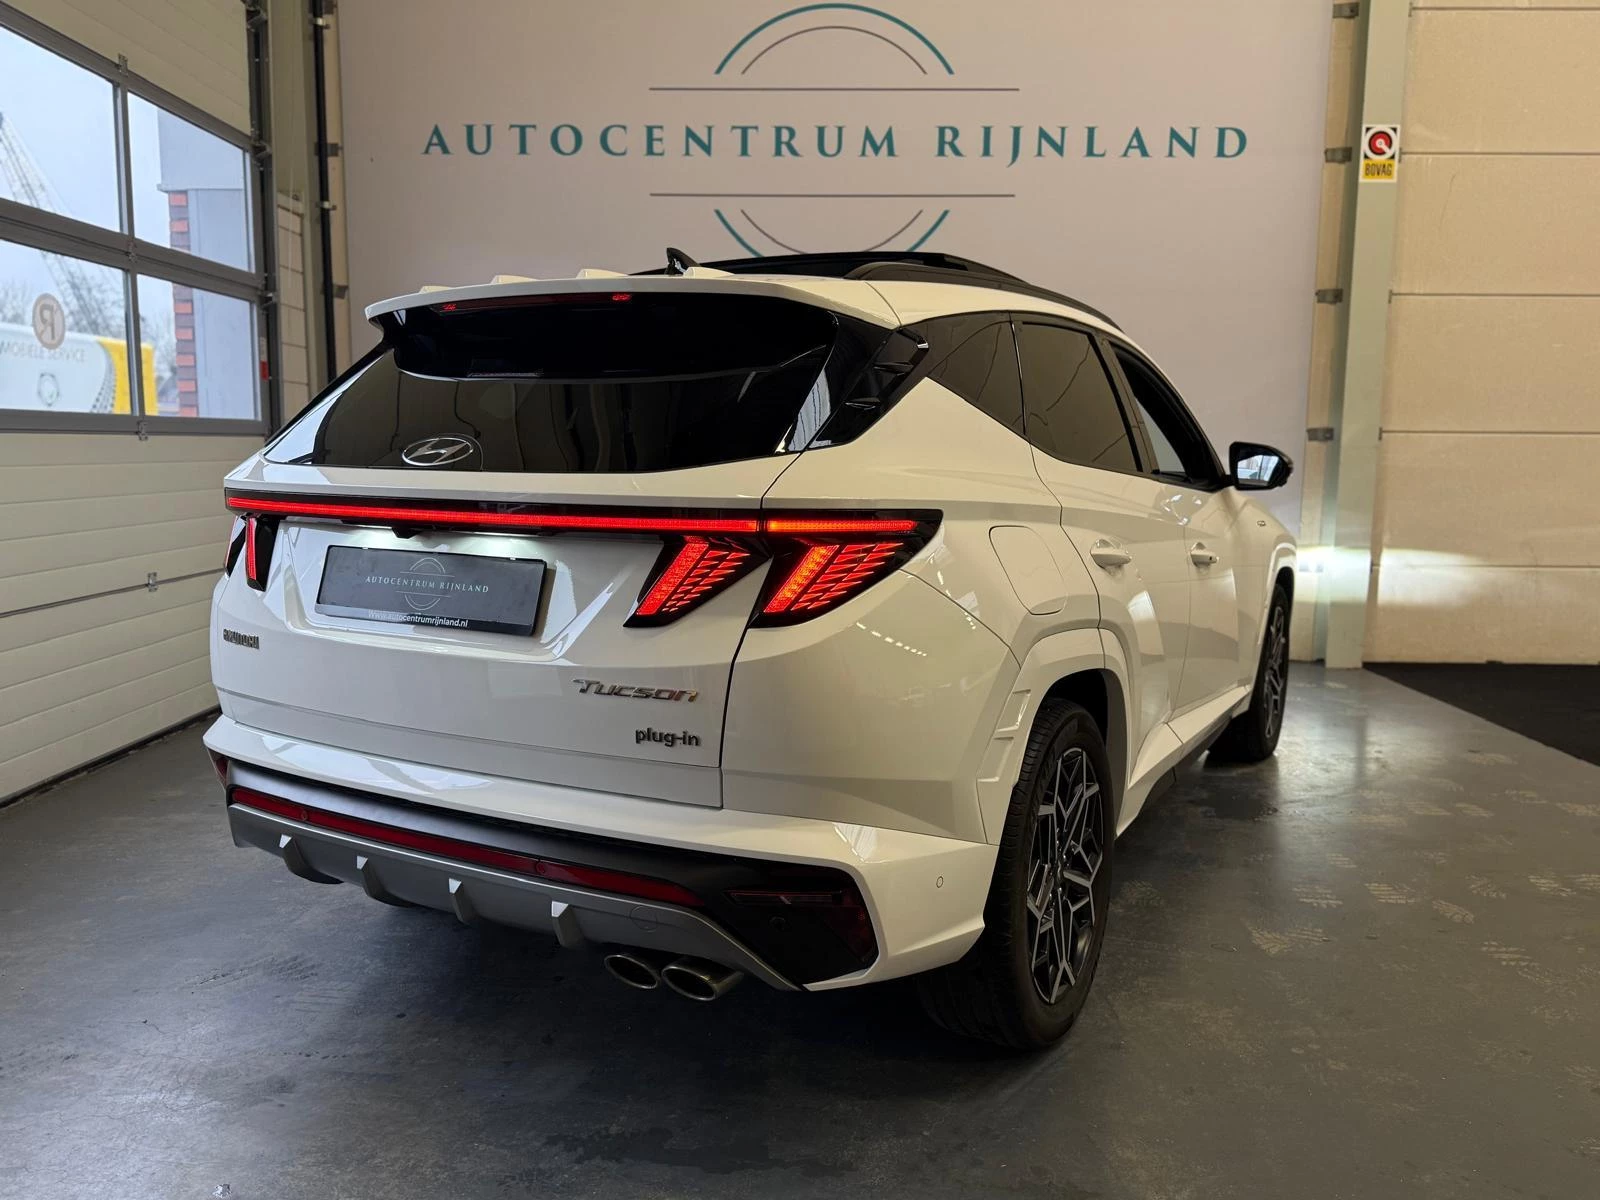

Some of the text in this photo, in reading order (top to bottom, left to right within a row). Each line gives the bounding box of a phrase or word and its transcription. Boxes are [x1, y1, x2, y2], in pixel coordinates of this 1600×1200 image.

[421, 123, 1248, 168] AUTOCENTRUM RIJNLAND
[1364, 162, 1393, 177] BOVAG
[364, 575, 490, 594] AUTOCENTRUM RIJNLAND
[635, 727, 700, 747] plug-in
